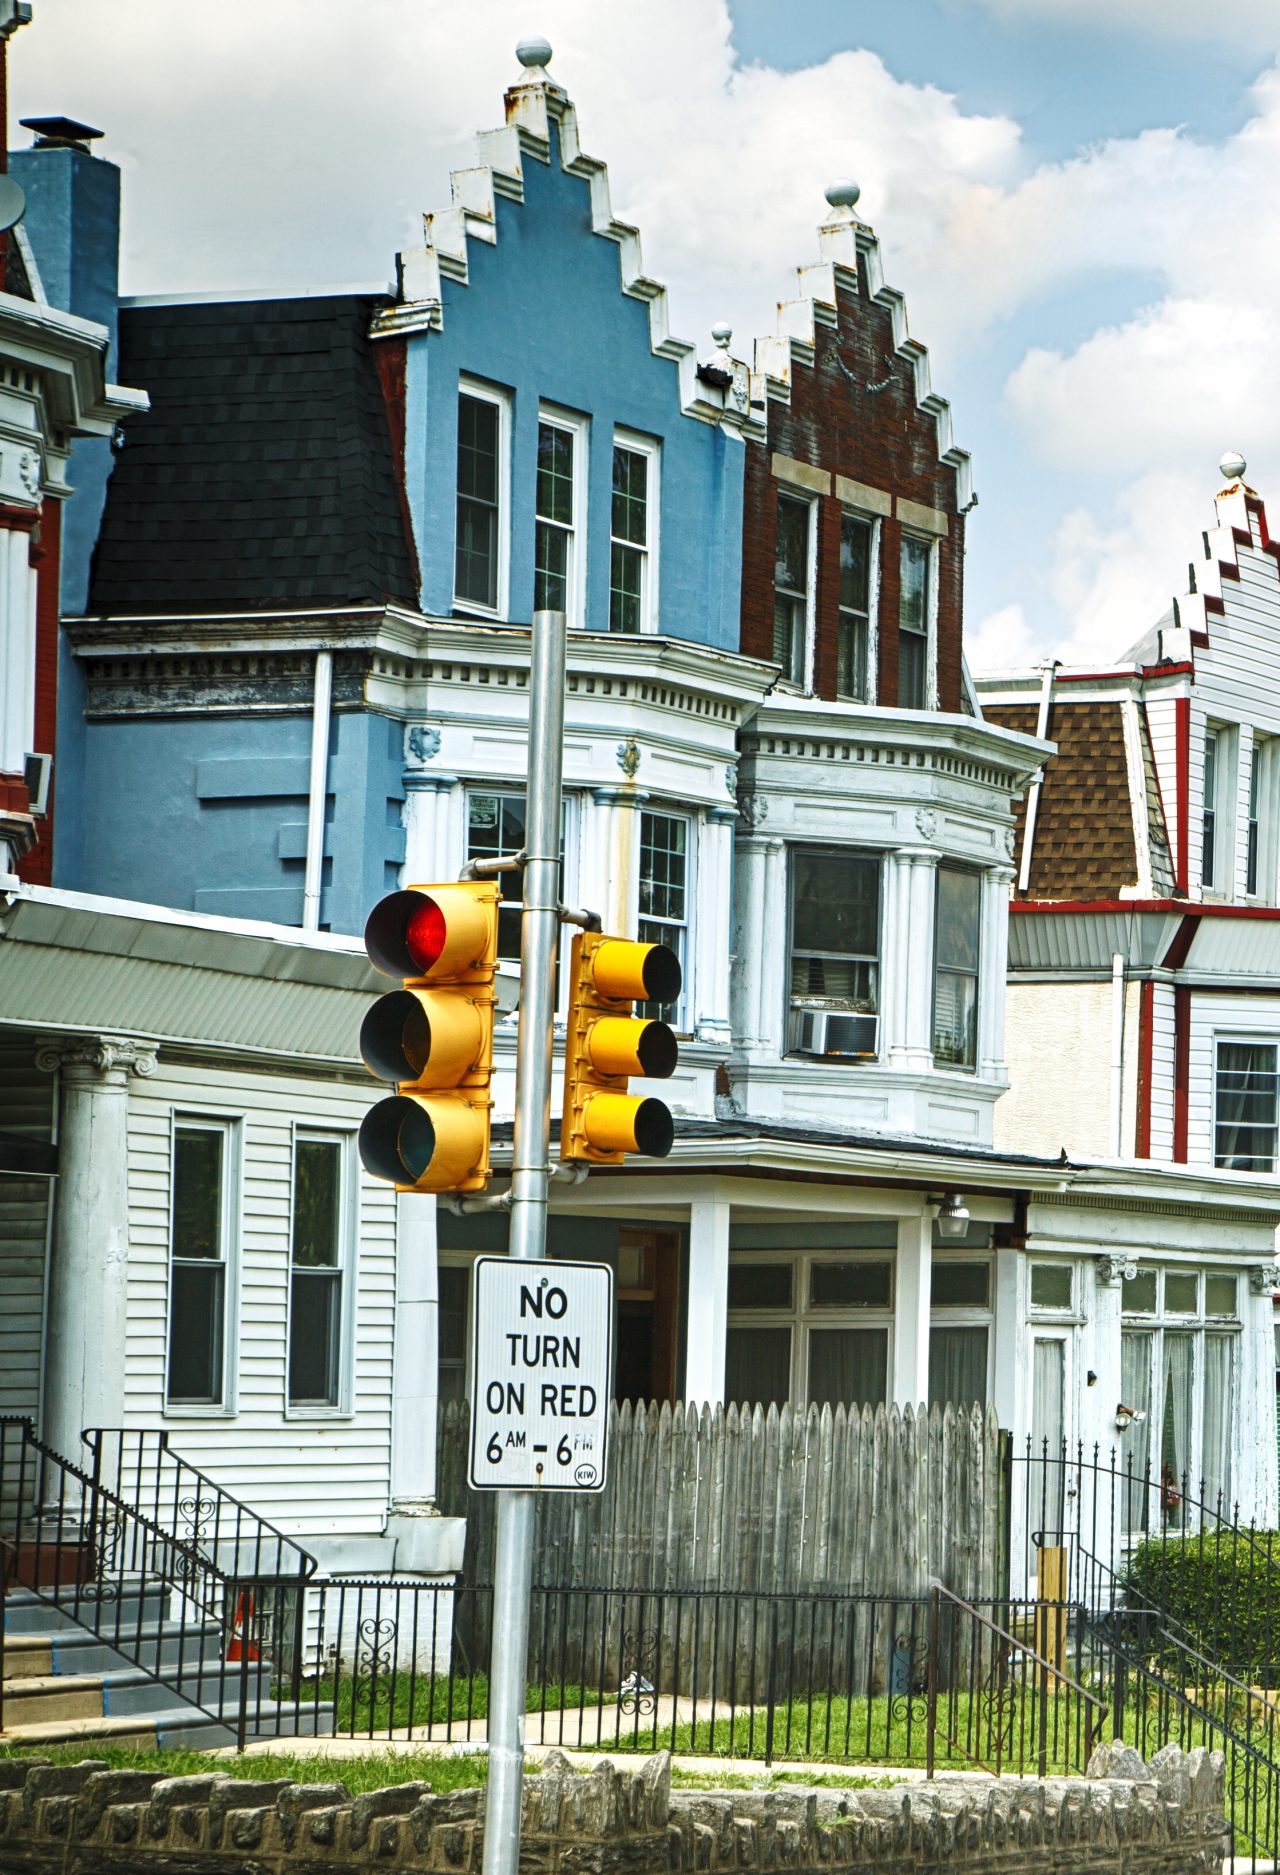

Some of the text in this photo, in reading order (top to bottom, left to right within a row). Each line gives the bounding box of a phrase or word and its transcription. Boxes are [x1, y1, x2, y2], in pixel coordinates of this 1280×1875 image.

[520, 1285, 568, 1319] NO
[506, 1333, 581, 1368] TURN
[486, 1381, 597, 1417] ON RED
[533, 1444, 548, 1453] -
[577, 1470, 594, 1480] KIW
